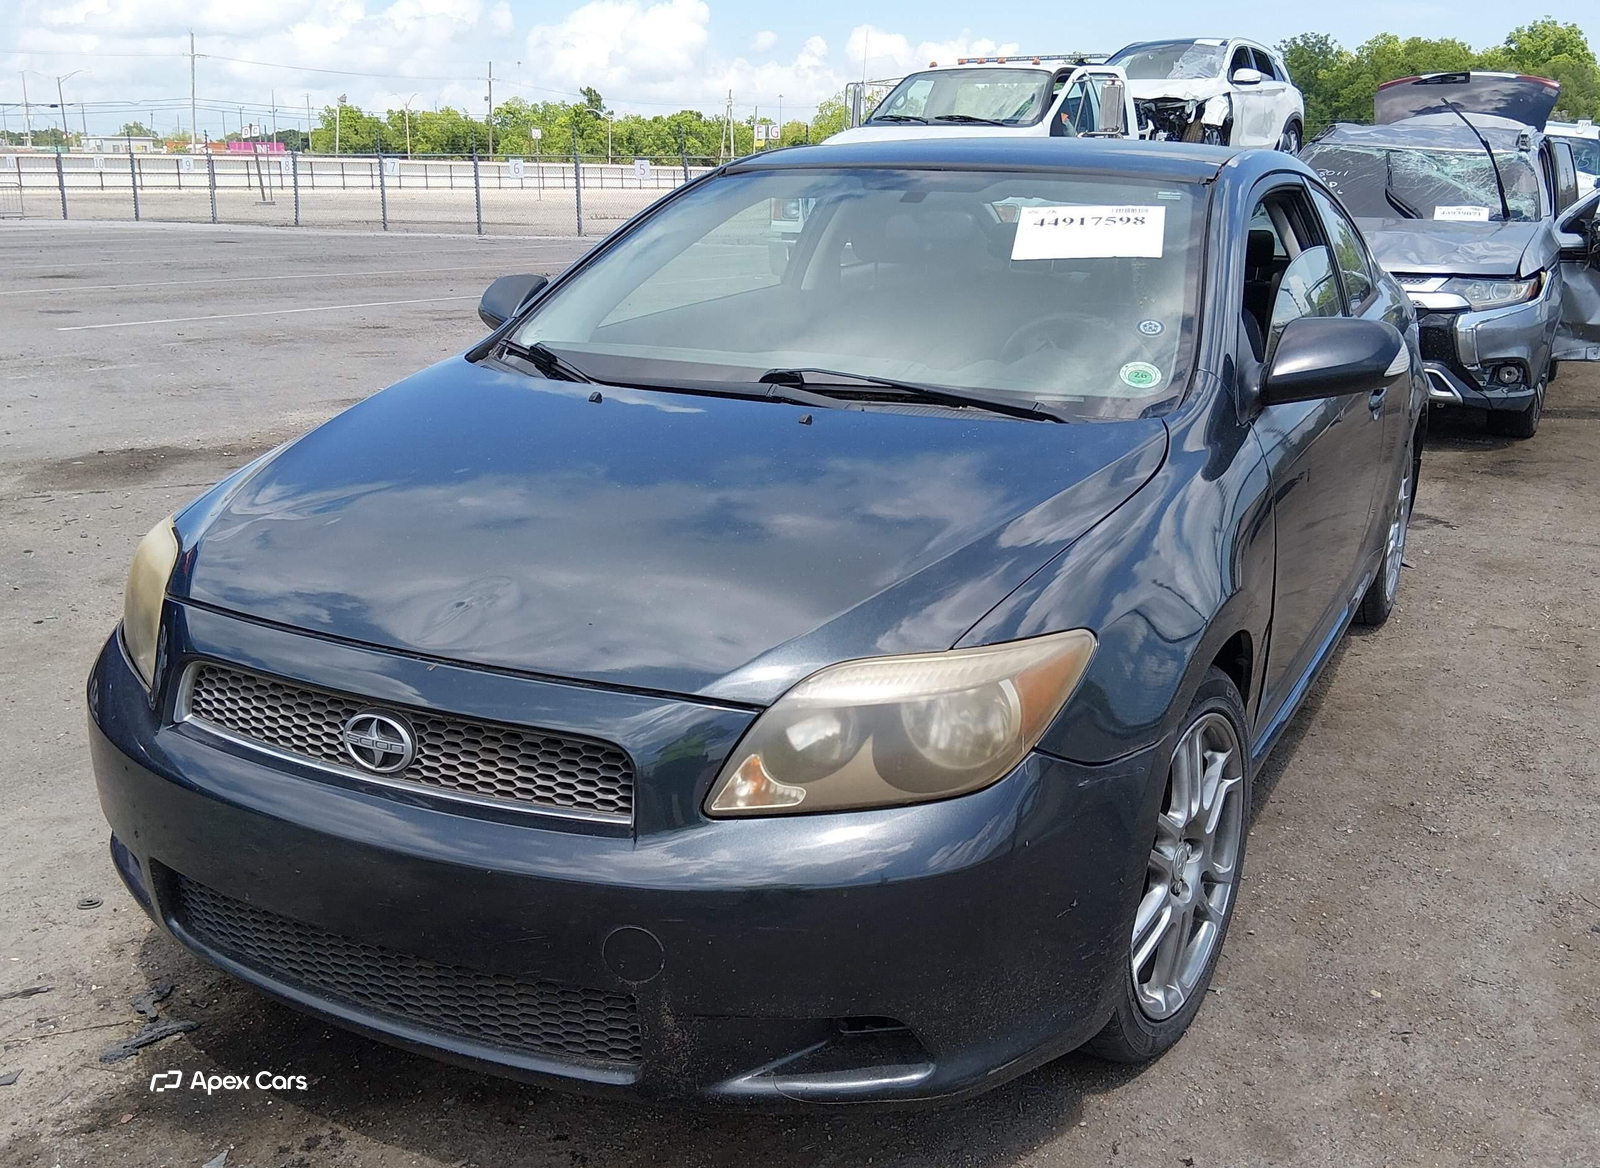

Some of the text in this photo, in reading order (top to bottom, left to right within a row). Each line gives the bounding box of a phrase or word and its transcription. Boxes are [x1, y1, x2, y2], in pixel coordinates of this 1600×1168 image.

[756, 125, 763, 138] F
[770, 125, 779, 138] G
[95, 159, 104, 169] 10
[186, 160, 191, 170] 9
[284, 160, 290, 171] 8
[390, 162, 395, 172] 7
[513, 163, 520, 174] 6
[640, 164, 646, 175] 5
[1033, 216, 1146, 227] 44917598
[1134, 371, 1148, 379] 26
